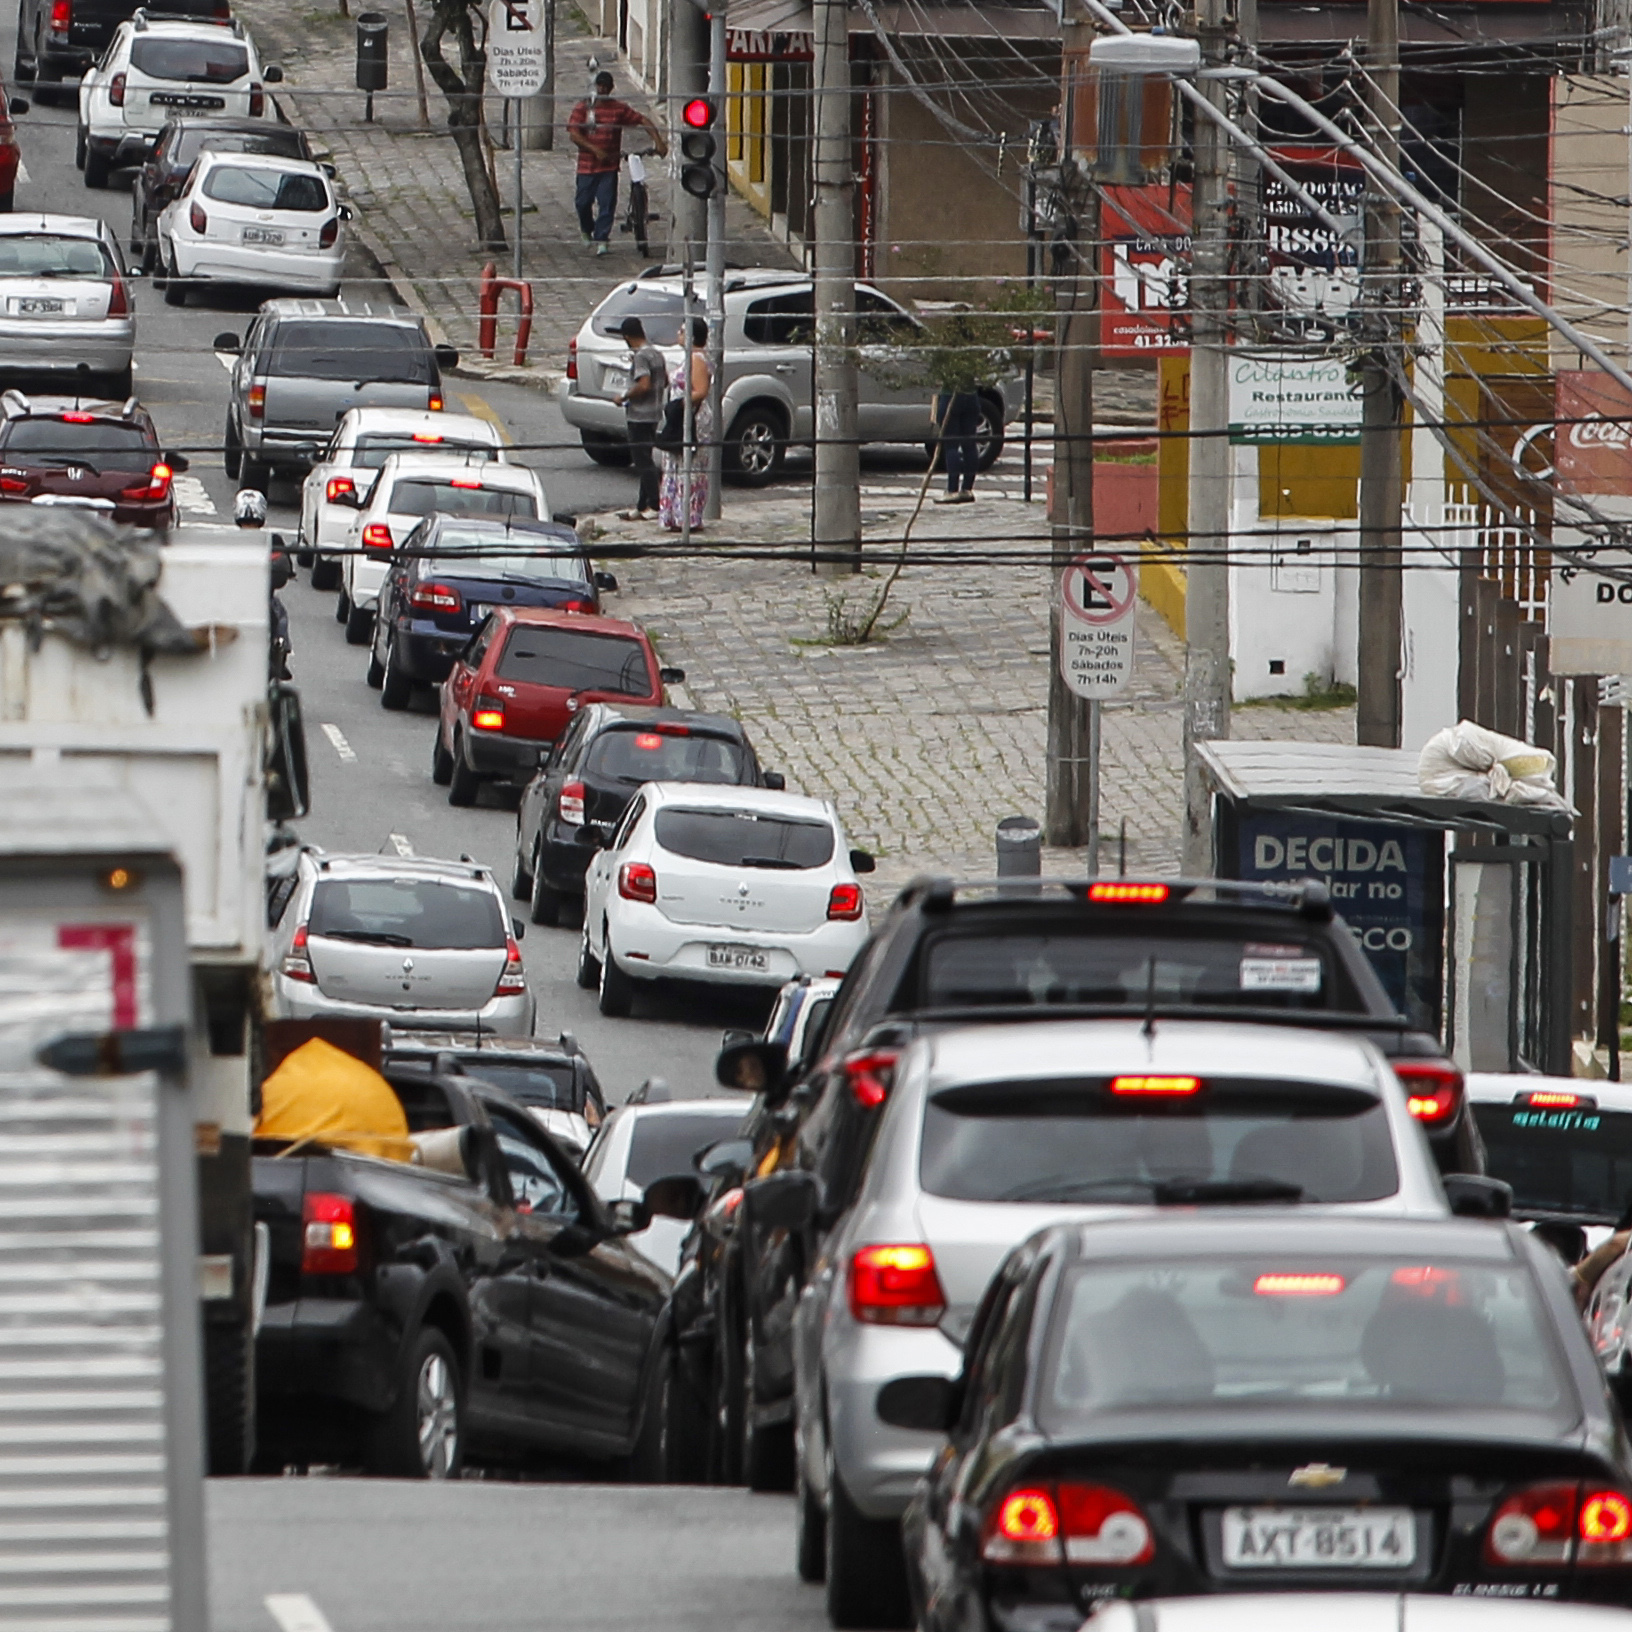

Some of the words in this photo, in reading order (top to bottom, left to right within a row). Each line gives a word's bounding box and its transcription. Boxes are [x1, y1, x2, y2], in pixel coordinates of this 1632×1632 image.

[493, 47, 514, 56] Dias
[517, 45, 542, 56] Úteis
[496, 67, 540, 78] Sábados
[1236, 362, 1339, 384] Cilantro
[1082, 562, 1117, 609] E
[1068, 631, 1093, 643] Dias
[1096, 628, 1128, 643] Úteis
[1070, 658, 1123, 671] Sábados
[1254, 835, 1407, 872] DECIDA
[1367, 881, 1403, 899] no
